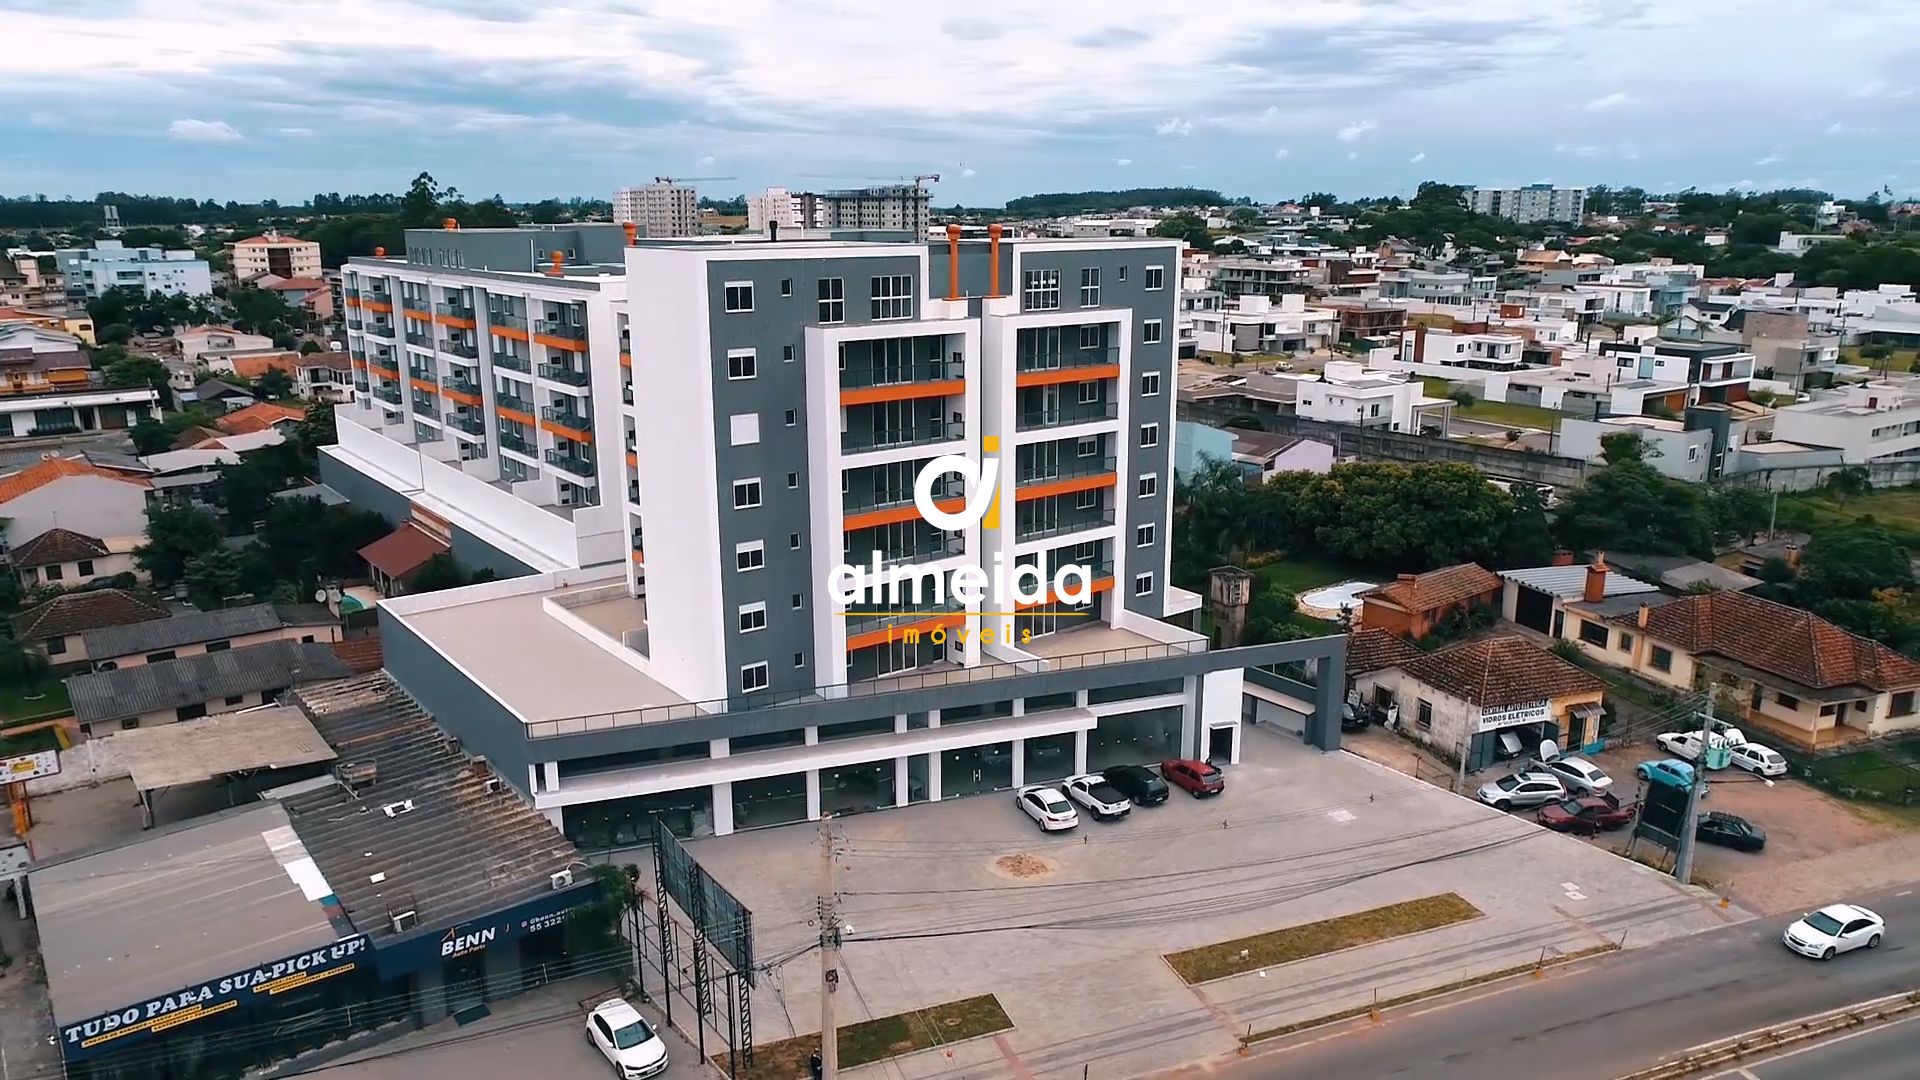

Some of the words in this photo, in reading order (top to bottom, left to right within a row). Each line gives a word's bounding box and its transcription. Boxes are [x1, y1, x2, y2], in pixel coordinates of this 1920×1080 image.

[1482, 714, 1507, 724] VIDROS
[1483, 705, 1506, 716] CENTRAL
[1507, 703, 1520, 712] AUTO
[441, 926, 496, 956] BENN
[65, 1008, 140, 1043] TUDO
[146, 986, 214, 1018] PARA
[331, 937, 366, 960] UP!
